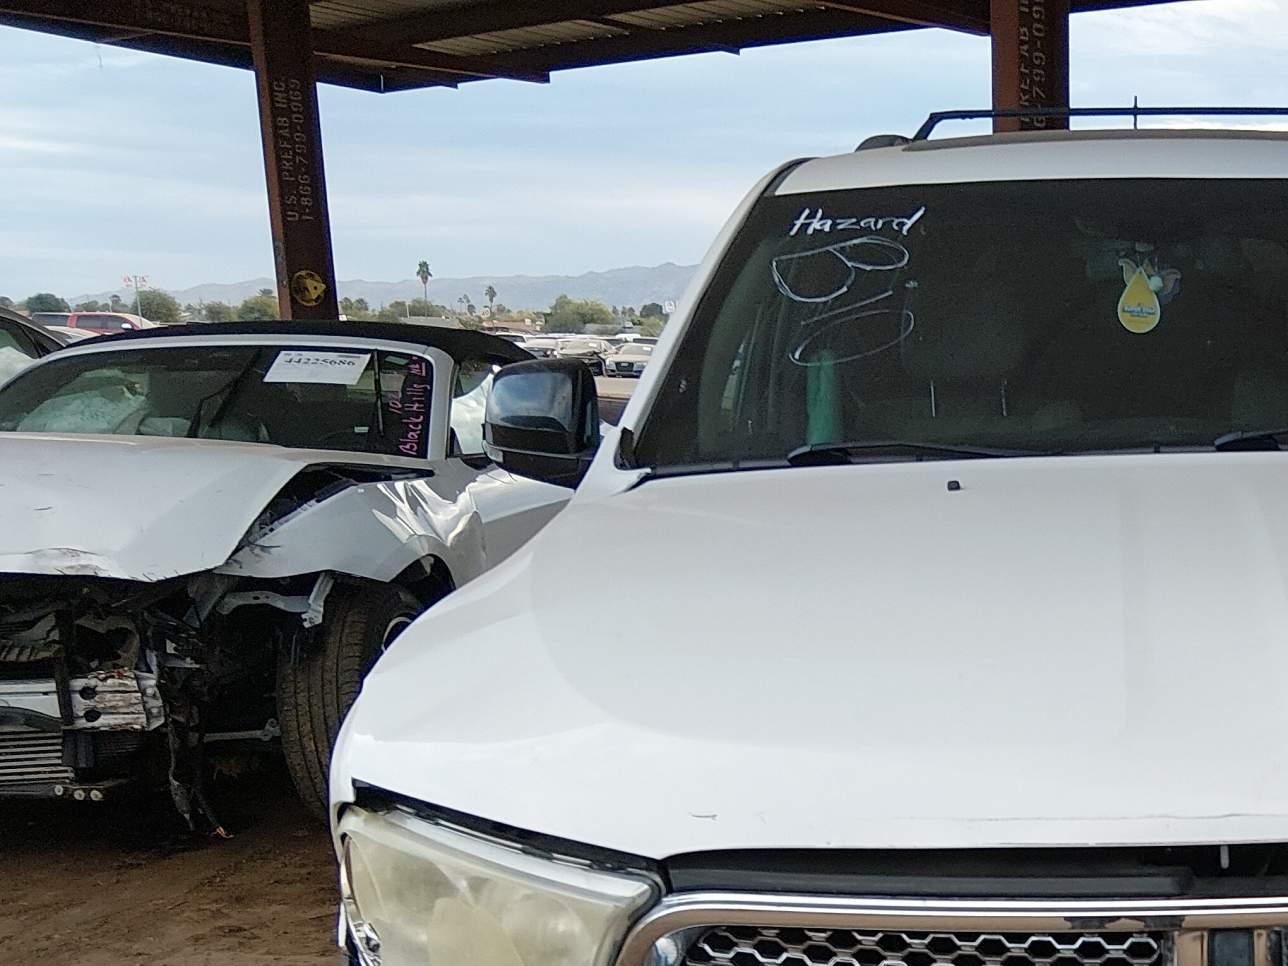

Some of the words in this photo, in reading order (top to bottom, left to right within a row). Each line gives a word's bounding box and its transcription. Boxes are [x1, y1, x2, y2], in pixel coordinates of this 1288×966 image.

[277, 117, 295, 181] PREFAB
[789, 206, 926, 236] Hazard
[284, 356, 356, 367] 44225686
[398, 415, 424, 456] Black
